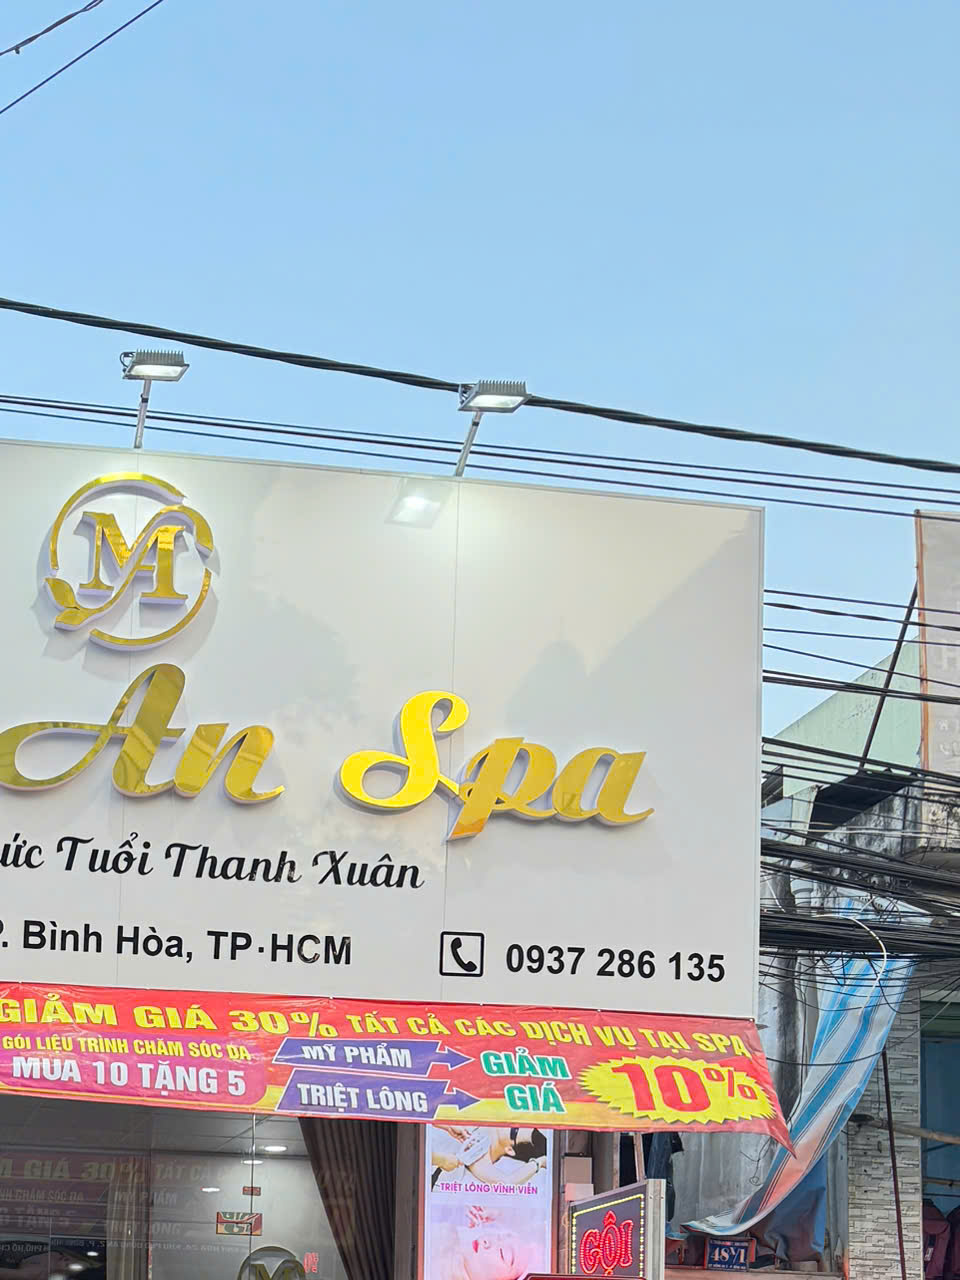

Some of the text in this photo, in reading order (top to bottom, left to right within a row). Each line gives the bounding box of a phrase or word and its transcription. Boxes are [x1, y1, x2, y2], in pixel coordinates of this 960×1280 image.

[338, 691, 655, 842] Spa
[55, 831, 153, 876] Tuổi
[165, 843, 302, 885] Thanh
[311, 849, 426, 890] Xuân
[22, 917, 103, 955] Bình
[116, 925, 193, 962] Hòa,
[505, 942, 726, 983] 0937 286 135
[2, 1034, 31, 1051] GÓI
[37, 1035, 73, 1056] LIỆU
[78, 1035, 129, 1054] TRÌNH
[135, 1037, 182, 1057] CHĂM
[188, 1041, 223, 1060] SÓC
[133, 1003, 218, 1031] GIÁ
[228, 1008, 339, 1039] 30%
[346, 1010, 401, 1034] TẤT
[406, 1012, 451, 1036] CẢ
[454, 1016, 518, 1038] CÁC
[520, 1019, 593, 1047] DỊCH
[595, 1026, 637, 1050] VỤ
[641, 1028, 691, 1055] TẠI
[696, 1032, 753, 1058] SPA
[302, 1042, 413, 1069] MỸ PHẨM
[480, 1047, 572, 1080] GIẢM
[12, 1057, 247, 1096] MUA 10 TẶNG 5
[611, 1063, 758, 1113] 10%
[297, 1083, 429, 1113] TRIỆT LÔNG
[504, 1083, 566, 1114] GIÁ
[464, 1181, 490, 1193] LÔNG
